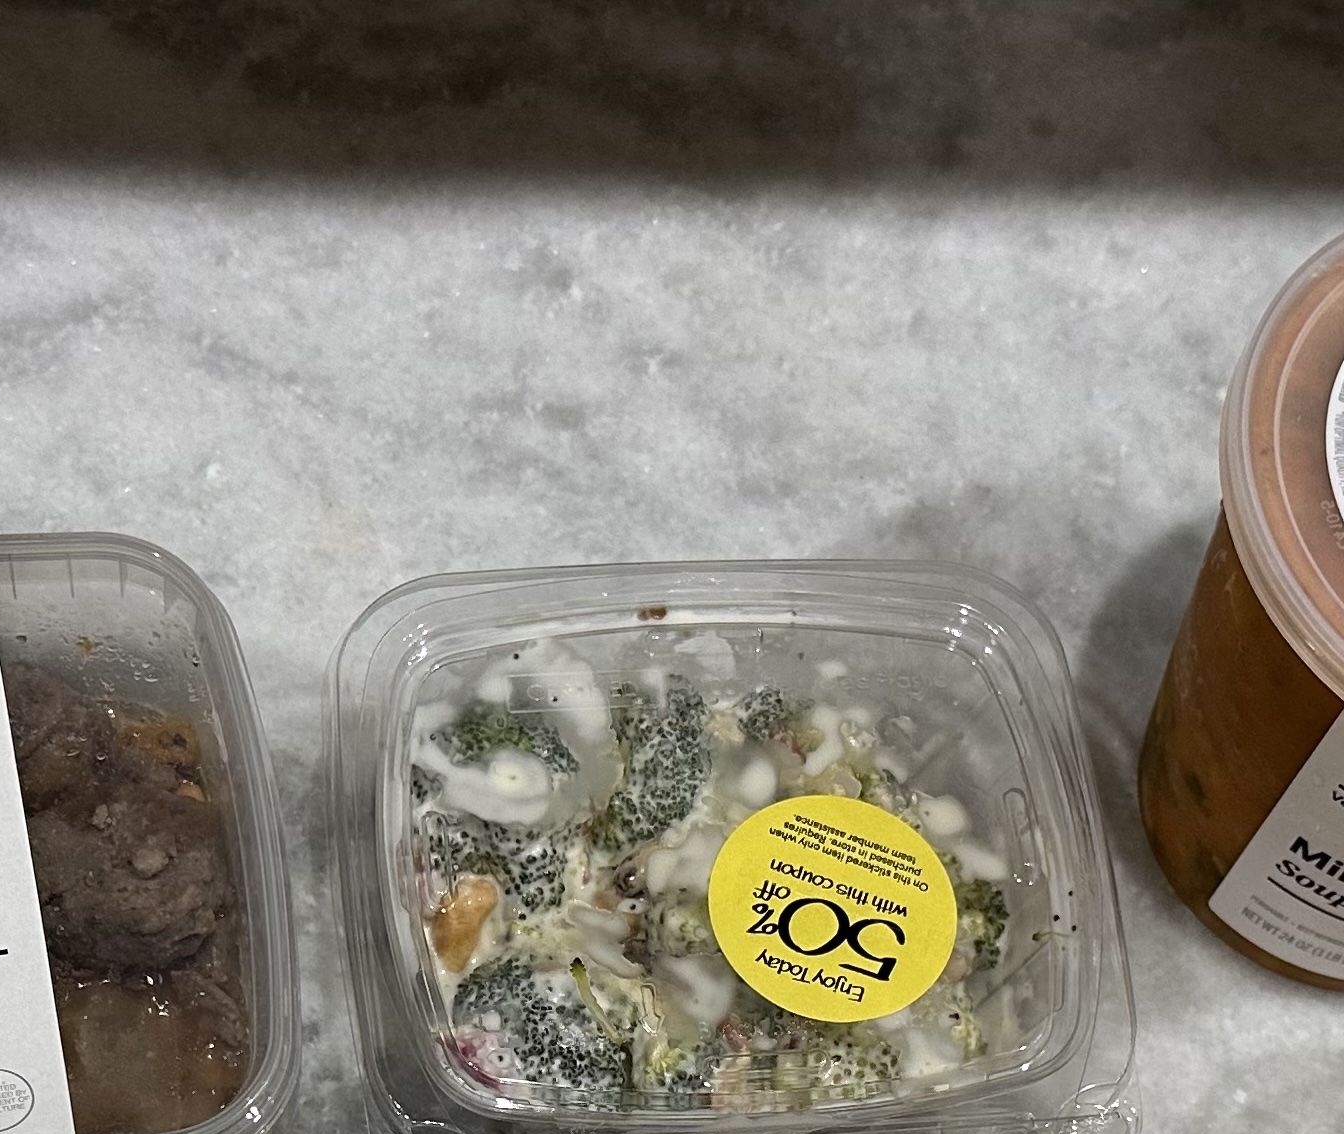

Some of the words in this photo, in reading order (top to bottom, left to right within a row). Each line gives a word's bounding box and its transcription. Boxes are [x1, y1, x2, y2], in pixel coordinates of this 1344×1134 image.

[770, 859, 834, 890] coupon
[752, 880, 791, 901] off
[836, 884, 869, 905] this
[871, 896, 907, 917] with
[746, 898, 906, 981] 50%
[755, 949, 810, 984] Today
[812, 969, 865, 1003] Enjoy
